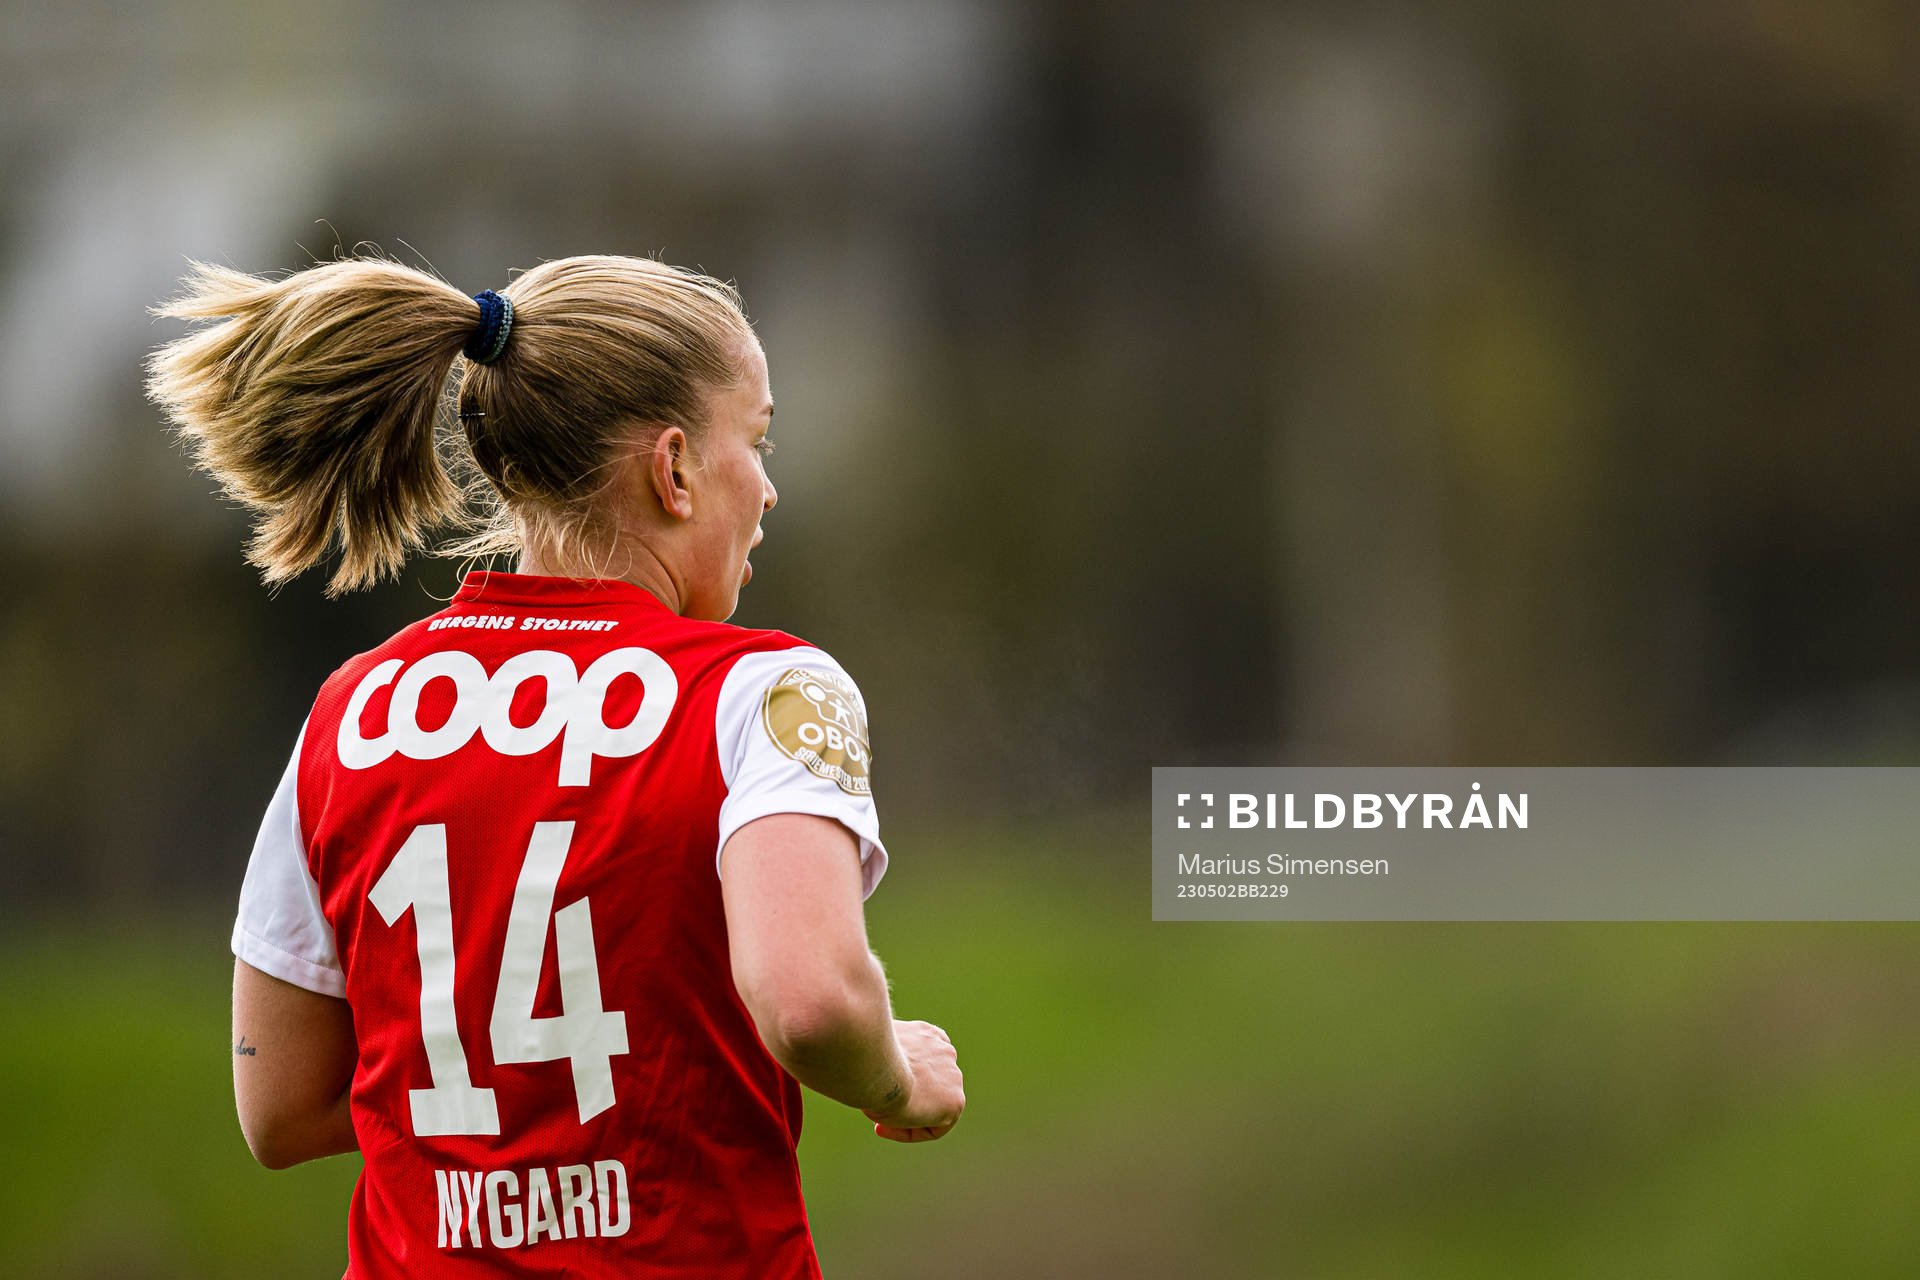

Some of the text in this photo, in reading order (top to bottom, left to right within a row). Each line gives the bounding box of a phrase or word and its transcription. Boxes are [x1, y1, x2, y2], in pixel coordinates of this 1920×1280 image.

[427, 615, 620, 632] BERGENS STOLTHET
[336, 646, 679, 788] coop
[367, 820, 630, 1138] 14
[434, 1159, 631, 1249] NYGARD
